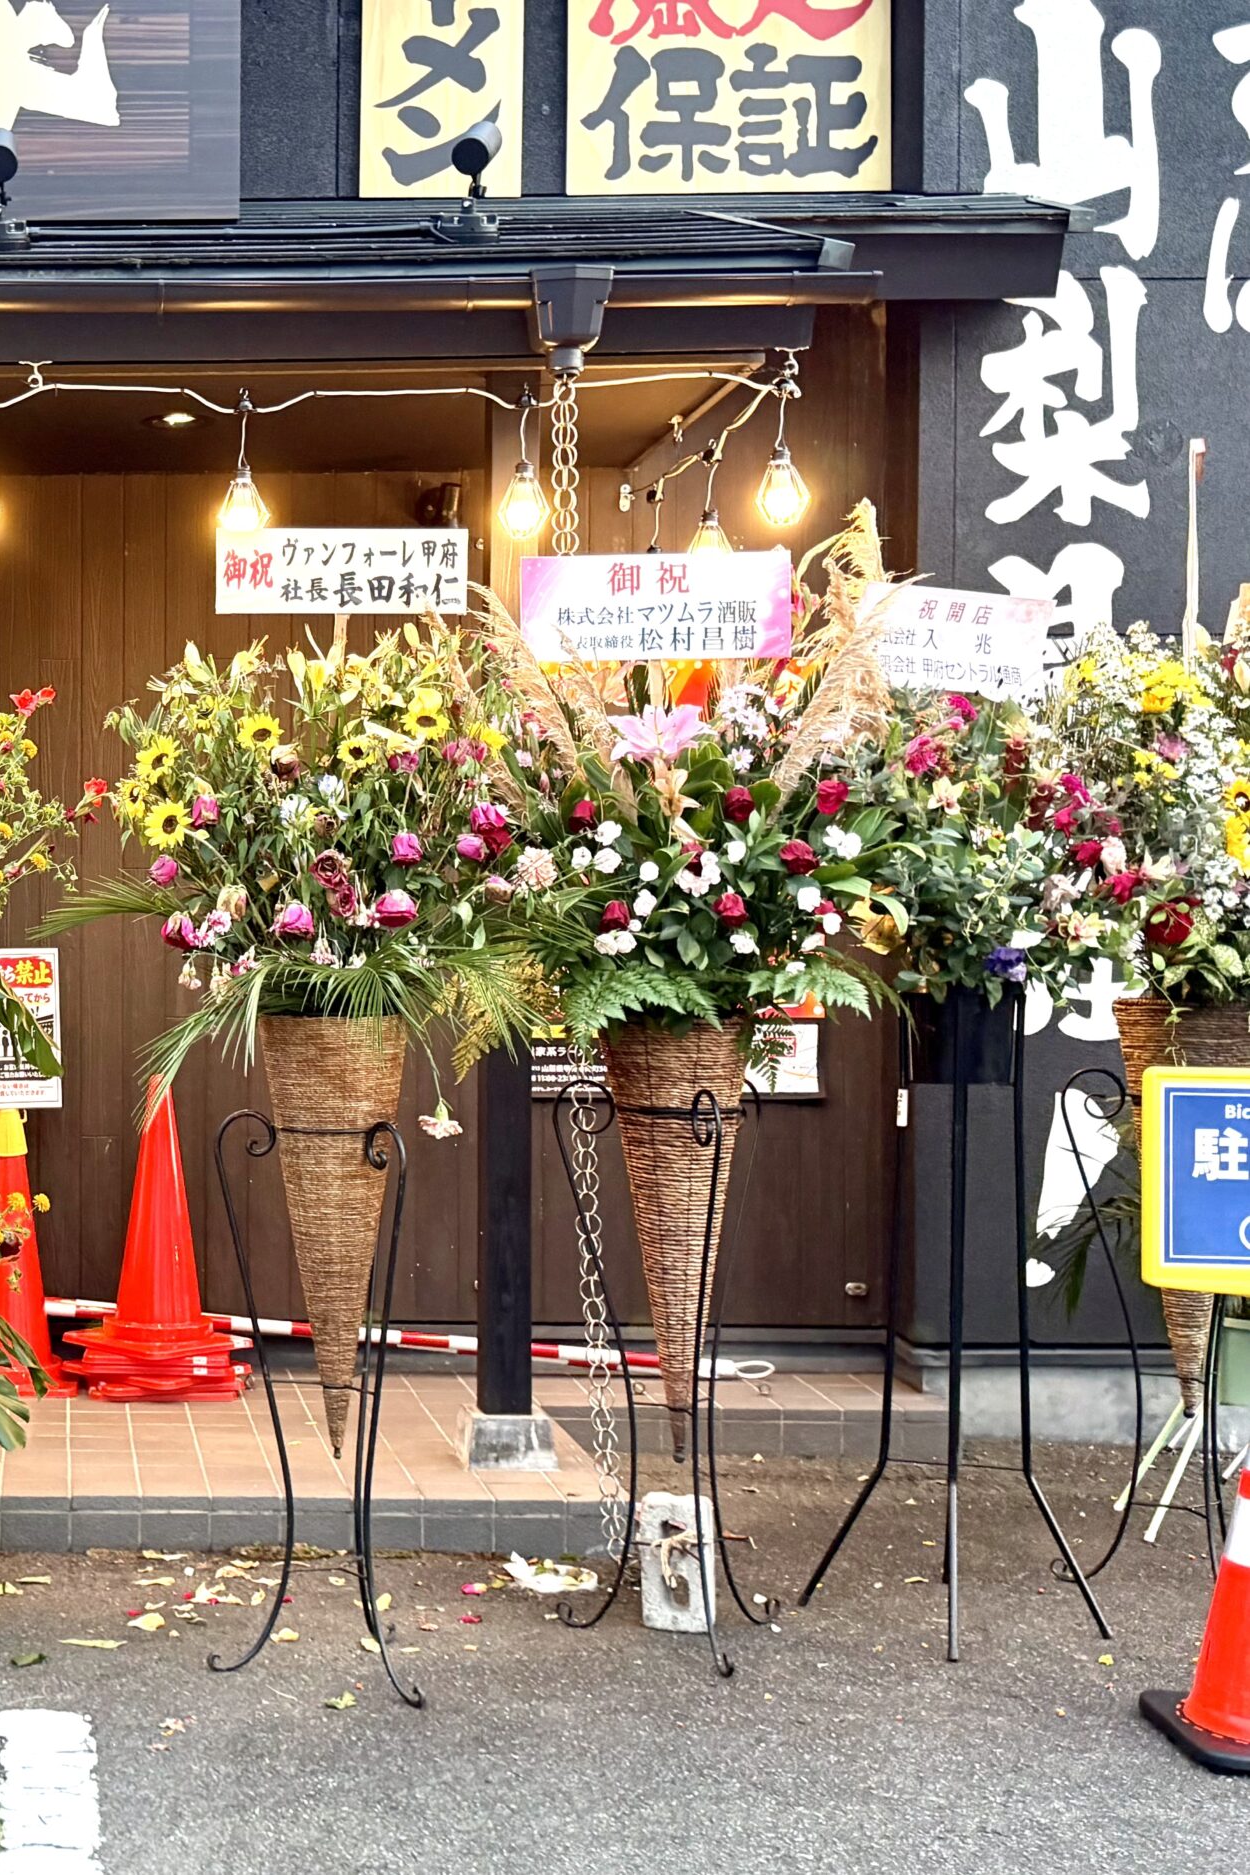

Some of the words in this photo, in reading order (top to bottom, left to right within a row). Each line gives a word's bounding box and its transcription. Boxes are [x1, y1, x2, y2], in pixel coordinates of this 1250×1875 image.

[373, 0, 502, 186] メン
[580, 43, 878, 181] 保証
[223, 549, 273, 590] 御祝
[282, 538, 459, 568] ヴァンフォーレ甲府
[607, 561, 690, 596] 御祝
[557, 600, 757, 626] 株式会社マツムラ酒販
[918, 598, 993, 625] 祝開店
[1192, 1127, 1249, 1182] 駐
